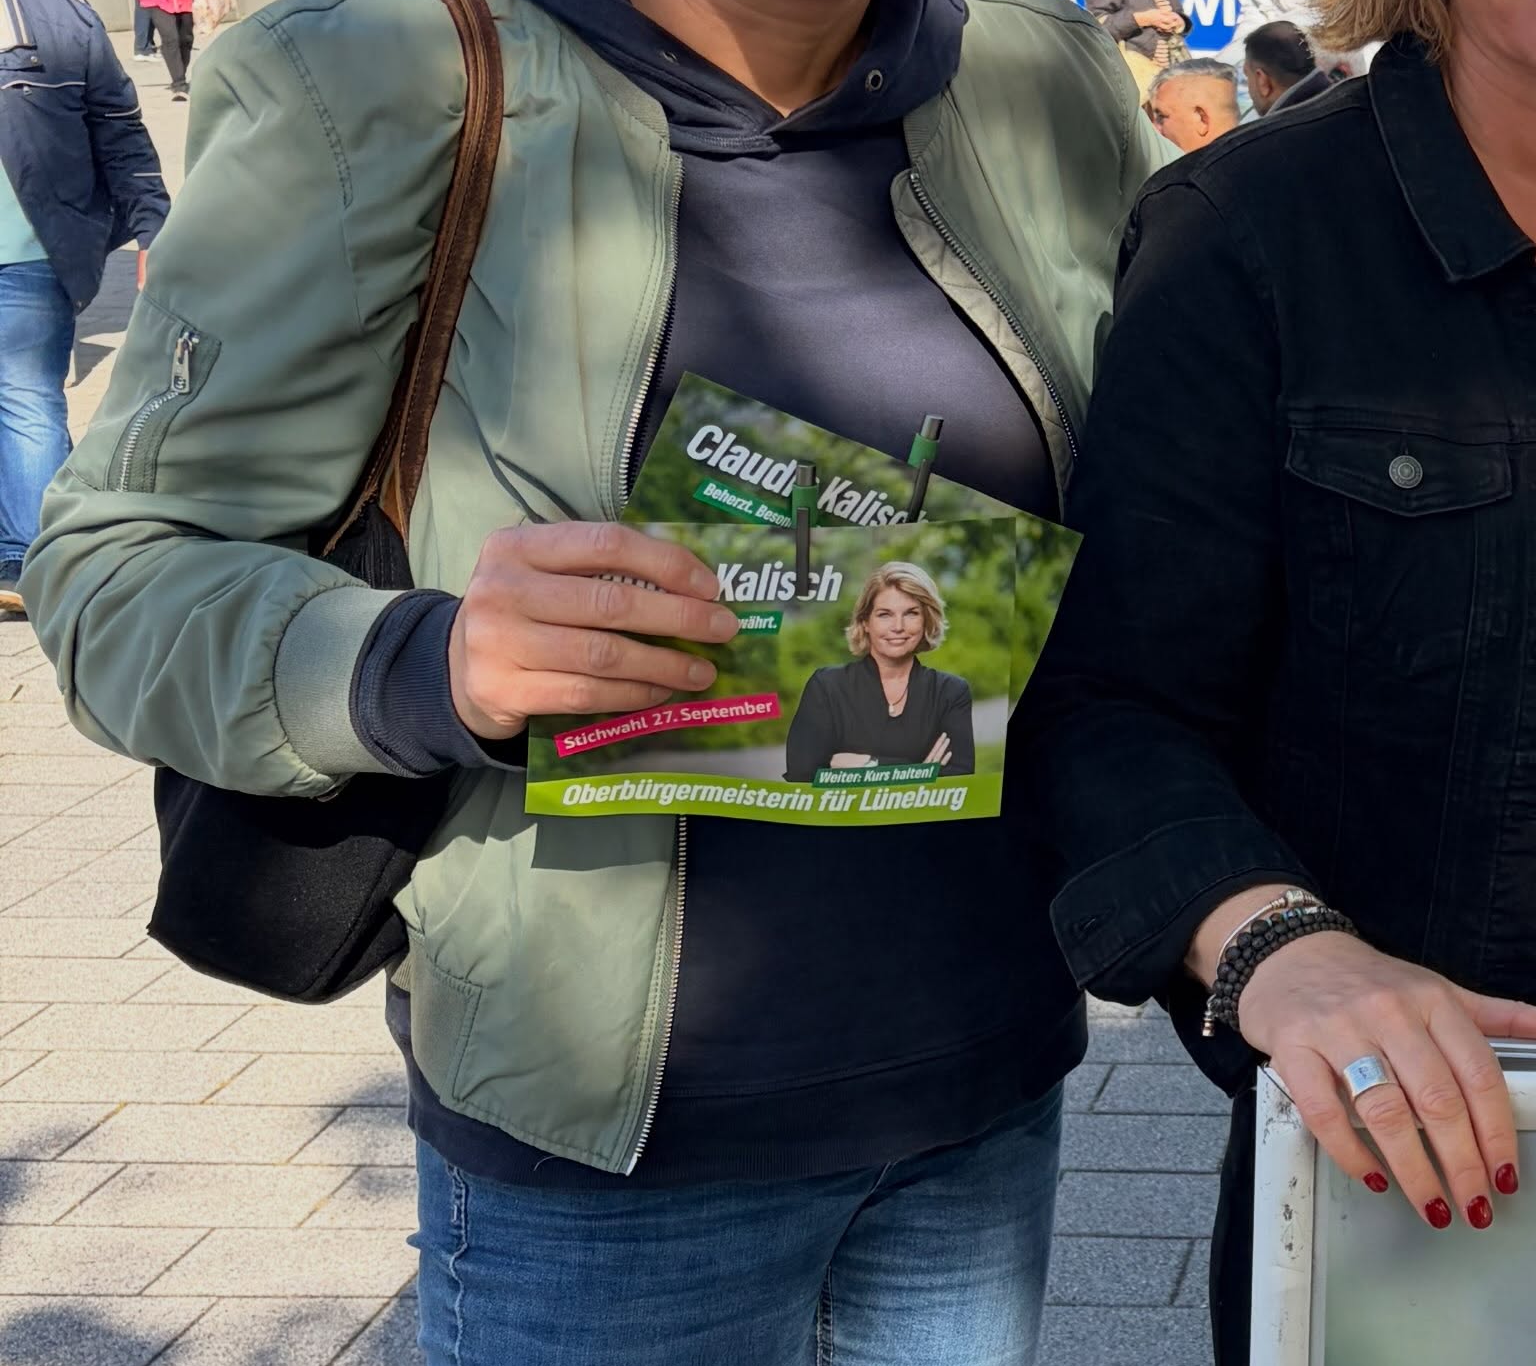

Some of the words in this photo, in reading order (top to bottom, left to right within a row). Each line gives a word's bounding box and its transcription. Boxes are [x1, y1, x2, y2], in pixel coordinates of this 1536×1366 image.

[703, 482, 753, 514] Beherzt.
[737, 611, 778, 630] währt.
[564, 716, 649, 751] Stichwahl
[652, 710, 679, 727] 27.
[680, 700, 773, 723] September
[863, 769, 891, 782] Kurs
[893, 766, 935, 781] halten!
[562, 781, 814, 812] Oberbürgermeisterin
[818, 788, 854, 812] für
[859, 785, 968, 812] Lüneburg
